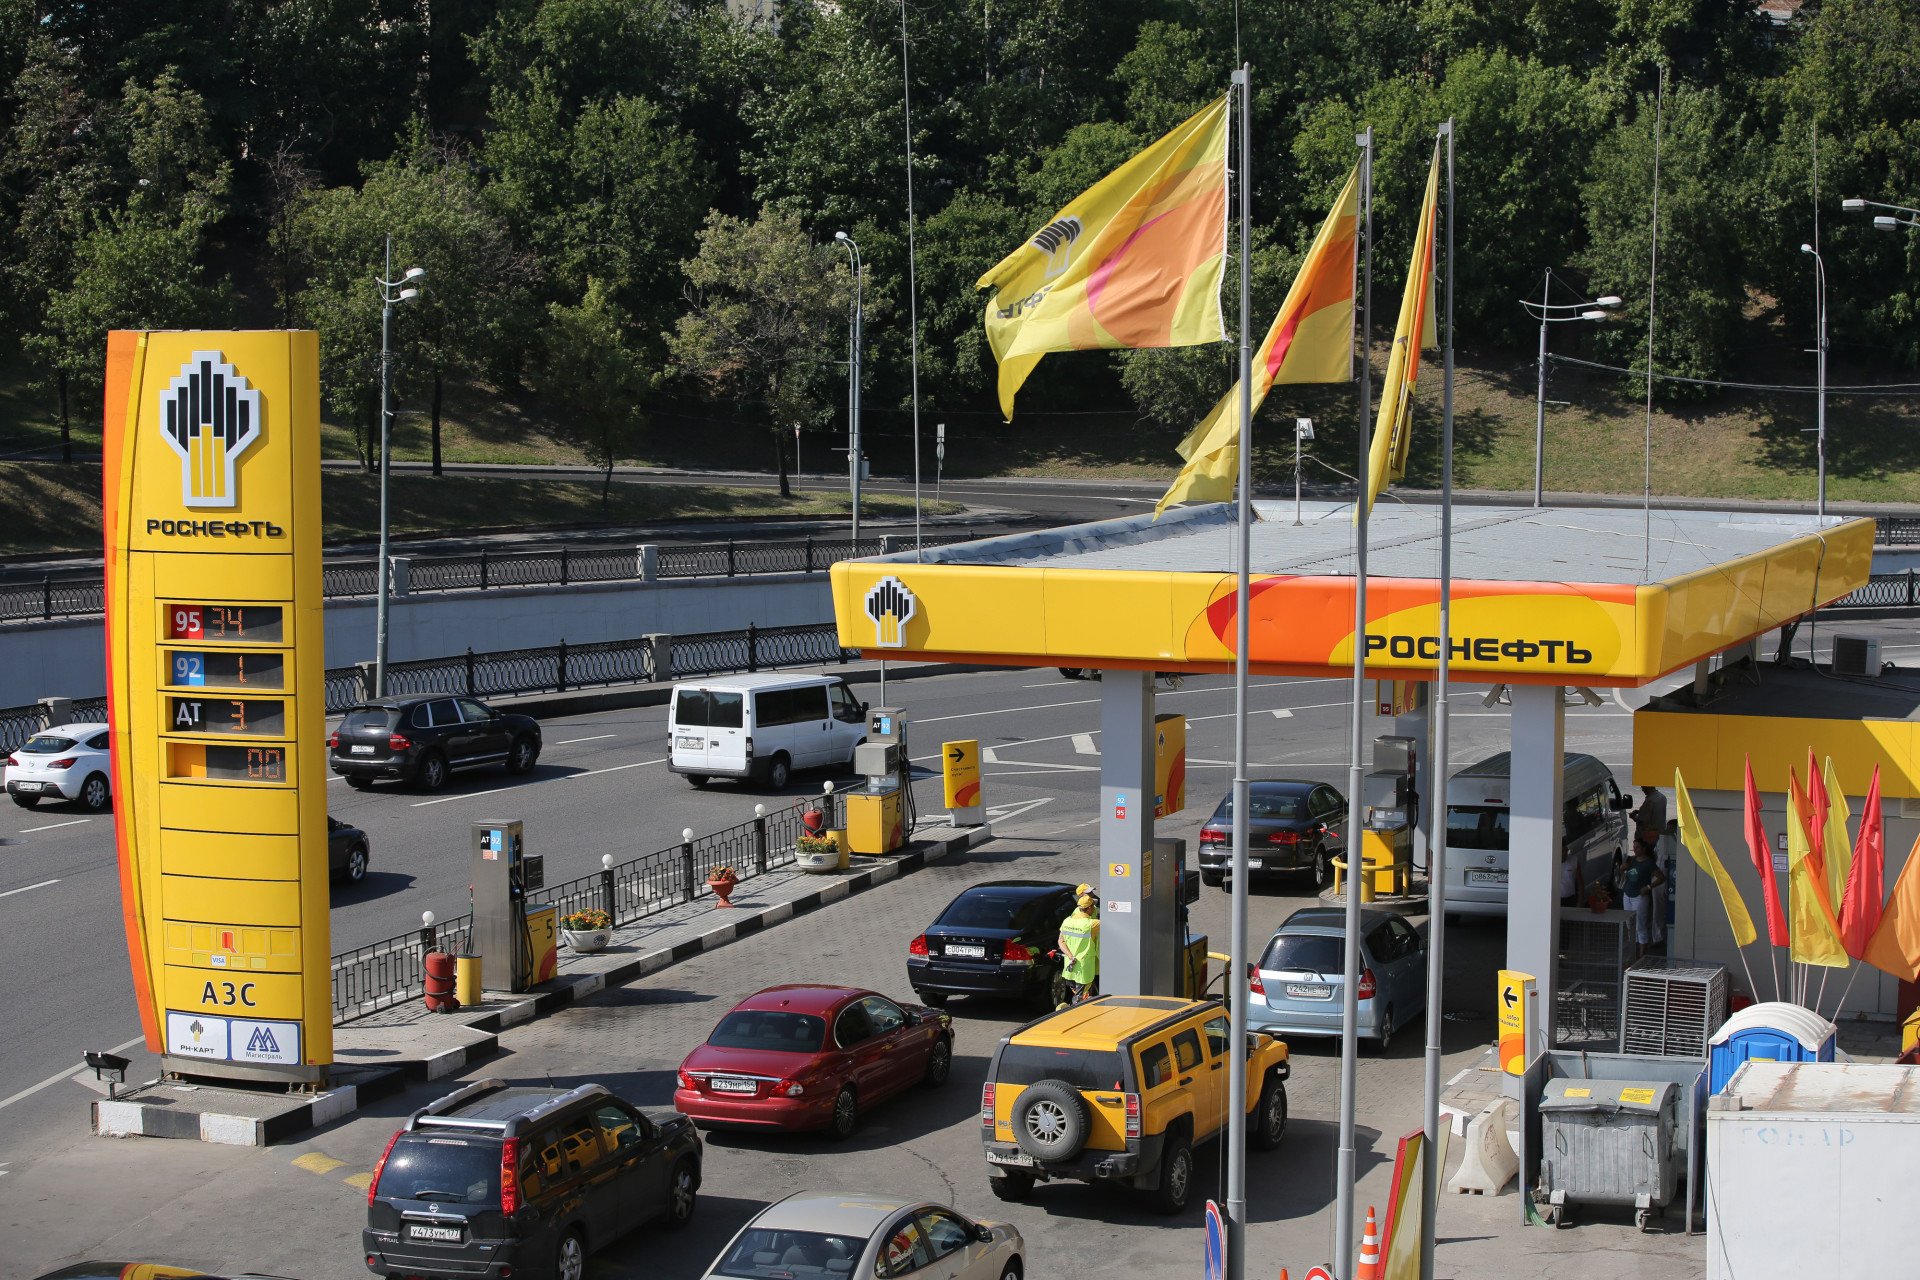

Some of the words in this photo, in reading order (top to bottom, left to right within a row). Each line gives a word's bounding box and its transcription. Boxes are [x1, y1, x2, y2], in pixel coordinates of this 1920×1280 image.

[147, 519, 284, 538] РОСНЕФТЬ
[175, 611, 200, 632] 95
[1365, 635, 1592, 664] РОСНЕФТЬ
[176, 657, 201, 678] 92
[176, 702, 201, 725] ДТ
[491, 837, 501, 845] 92
[546, 918, 553, 940] 5
[202, 981, 256, 1007] АЗС
[180, 1044, 215, 1054] РН-КАРТ
[246, 1052, 282, 1060] Магистраль
[713, 1080, 743, 1089] В239МР
[411, 1227, 446, 1238] У473УМ
[447, 1229, 459, 1237] 177
